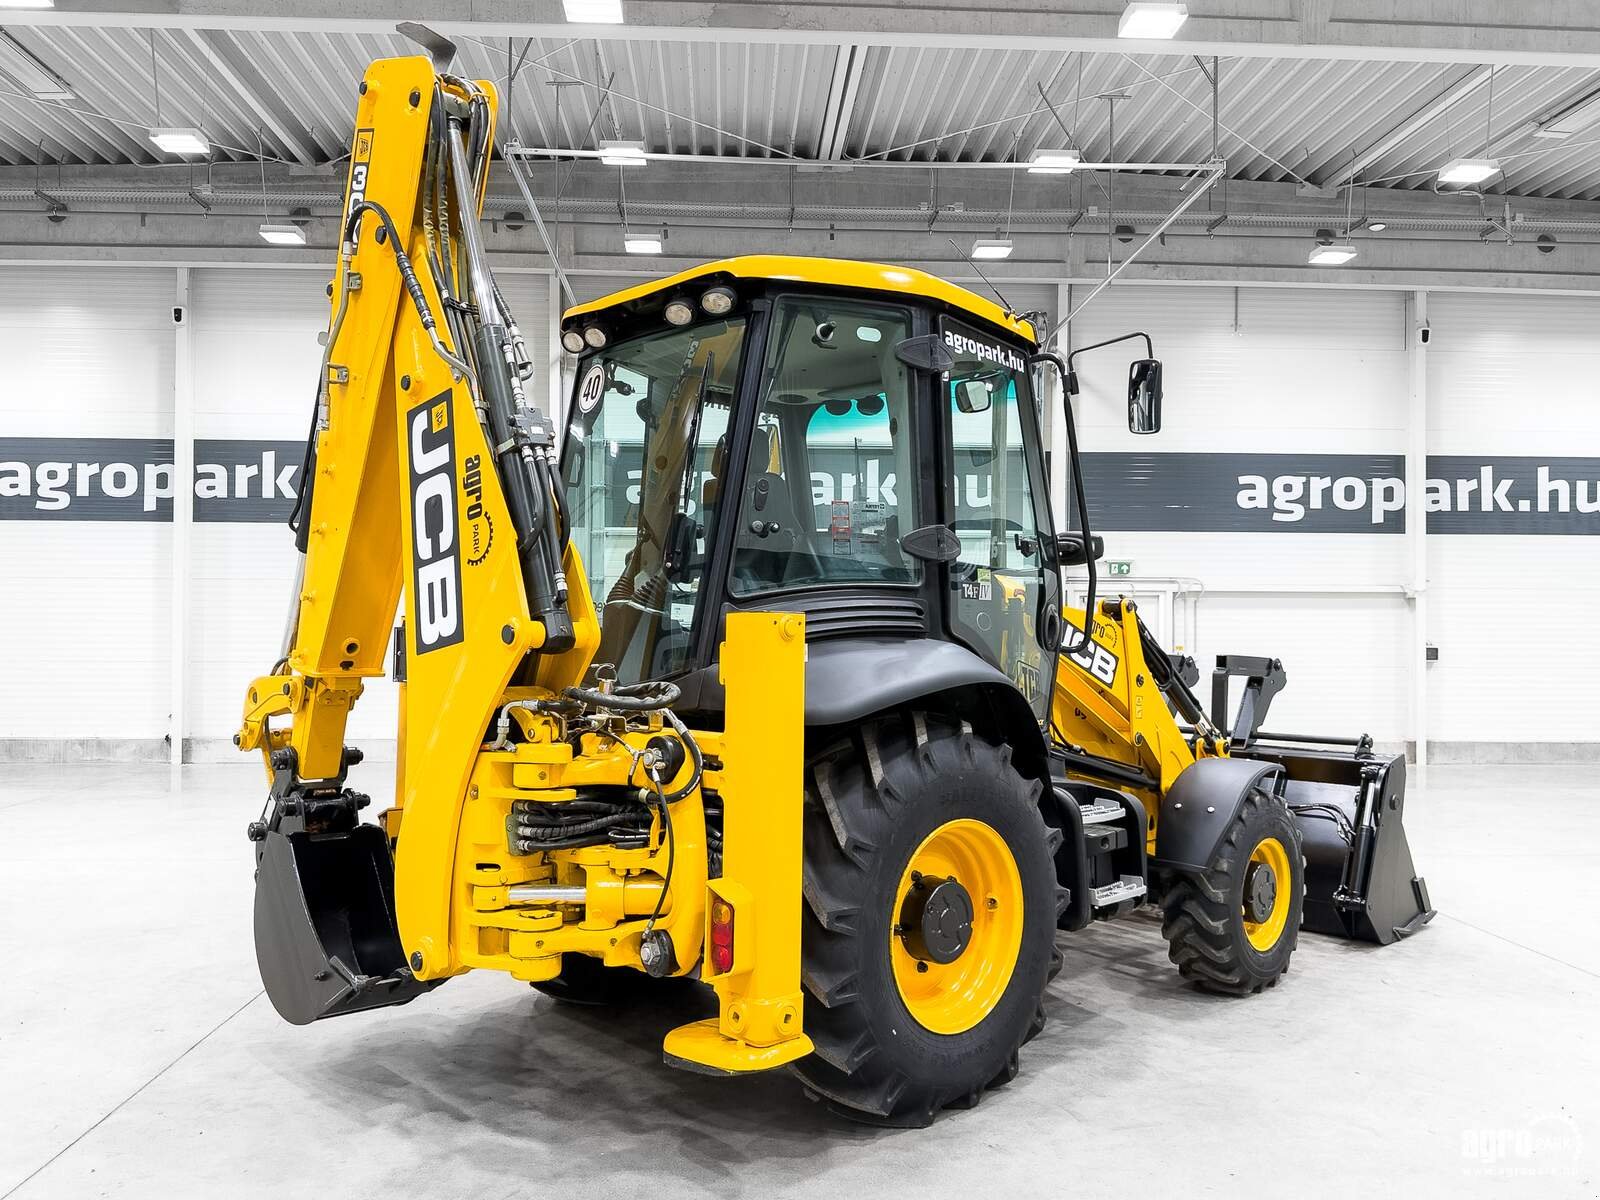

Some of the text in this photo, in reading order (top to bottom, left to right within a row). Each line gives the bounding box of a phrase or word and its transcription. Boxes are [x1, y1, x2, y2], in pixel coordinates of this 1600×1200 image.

[944, 330, 1025, 373] agropark.hu
[582, 374, 601, 402] 40
[412, 409, 458, 645] JCB
[463, 454, 483, 555] agro PARK
